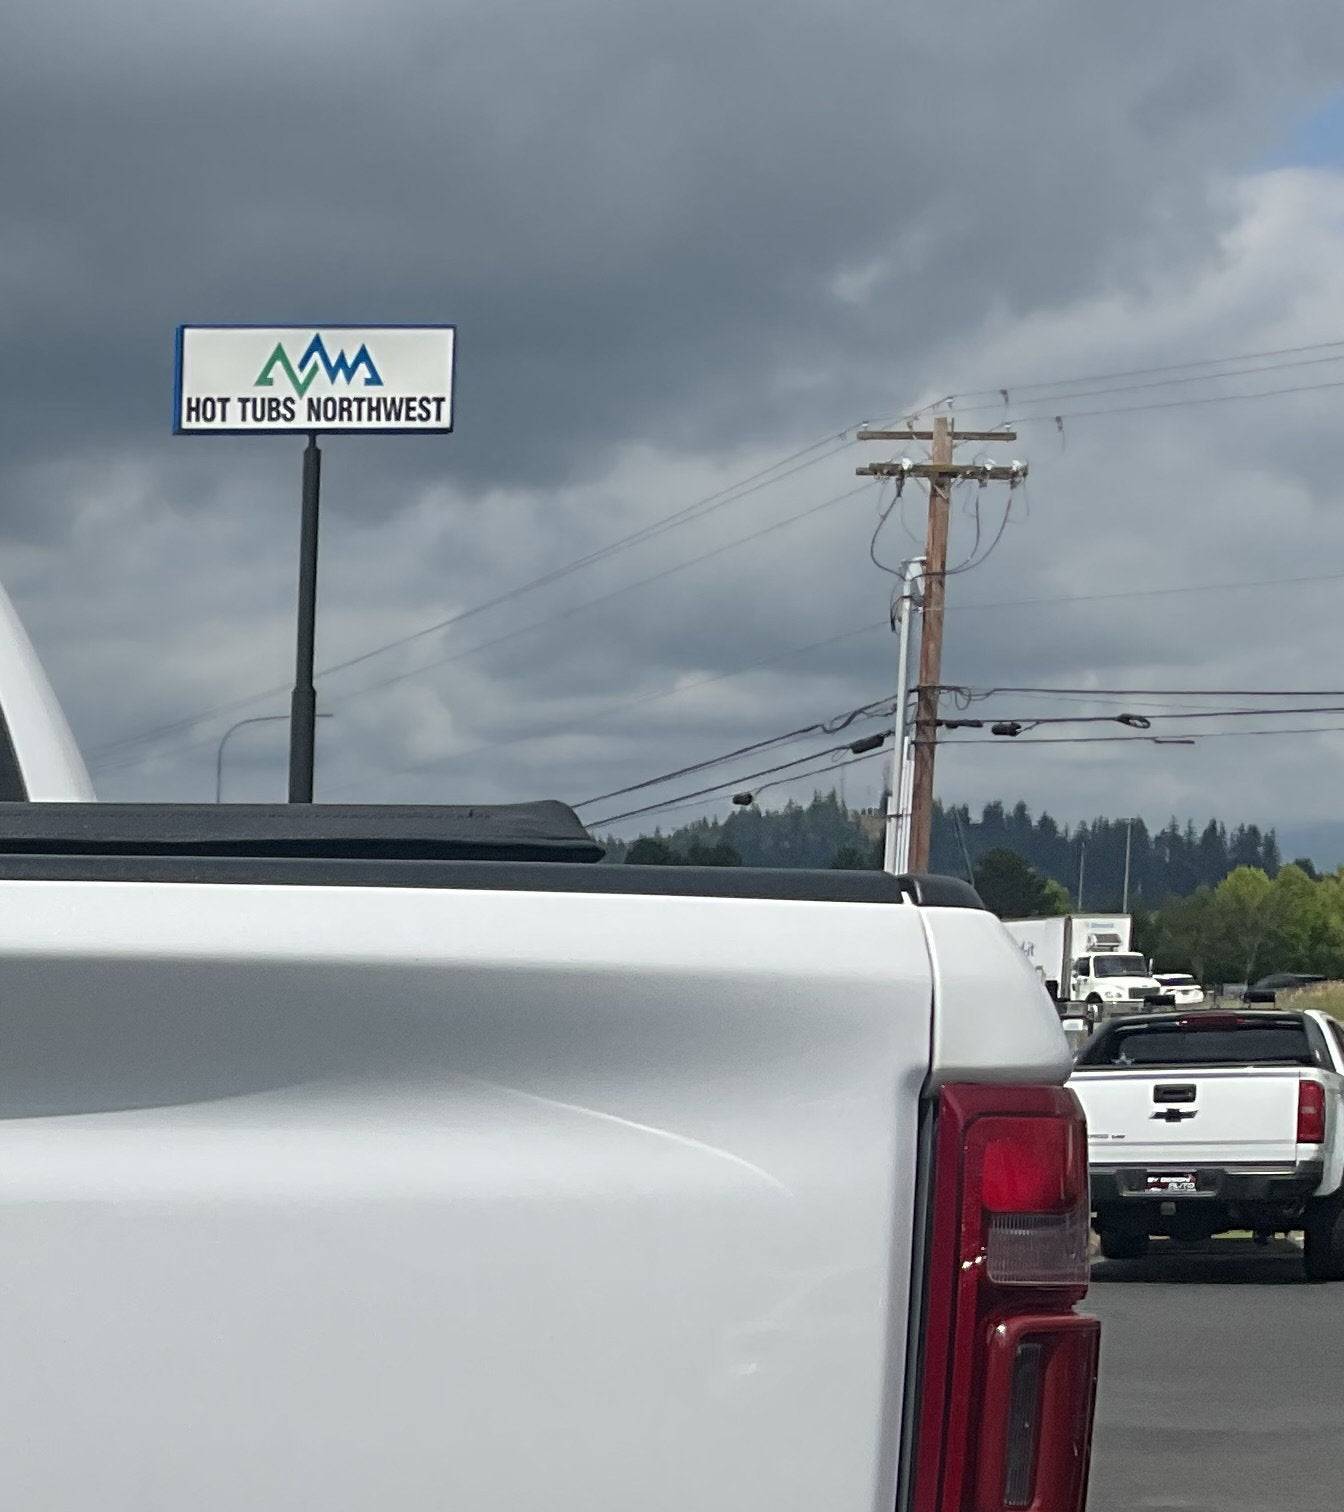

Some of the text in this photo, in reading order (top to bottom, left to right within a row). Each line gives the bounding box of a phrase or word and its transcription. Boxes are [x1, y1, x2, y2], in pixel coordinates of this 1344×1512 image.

[186, 397, 446, 422] HOT TUBS NORTHWEST
